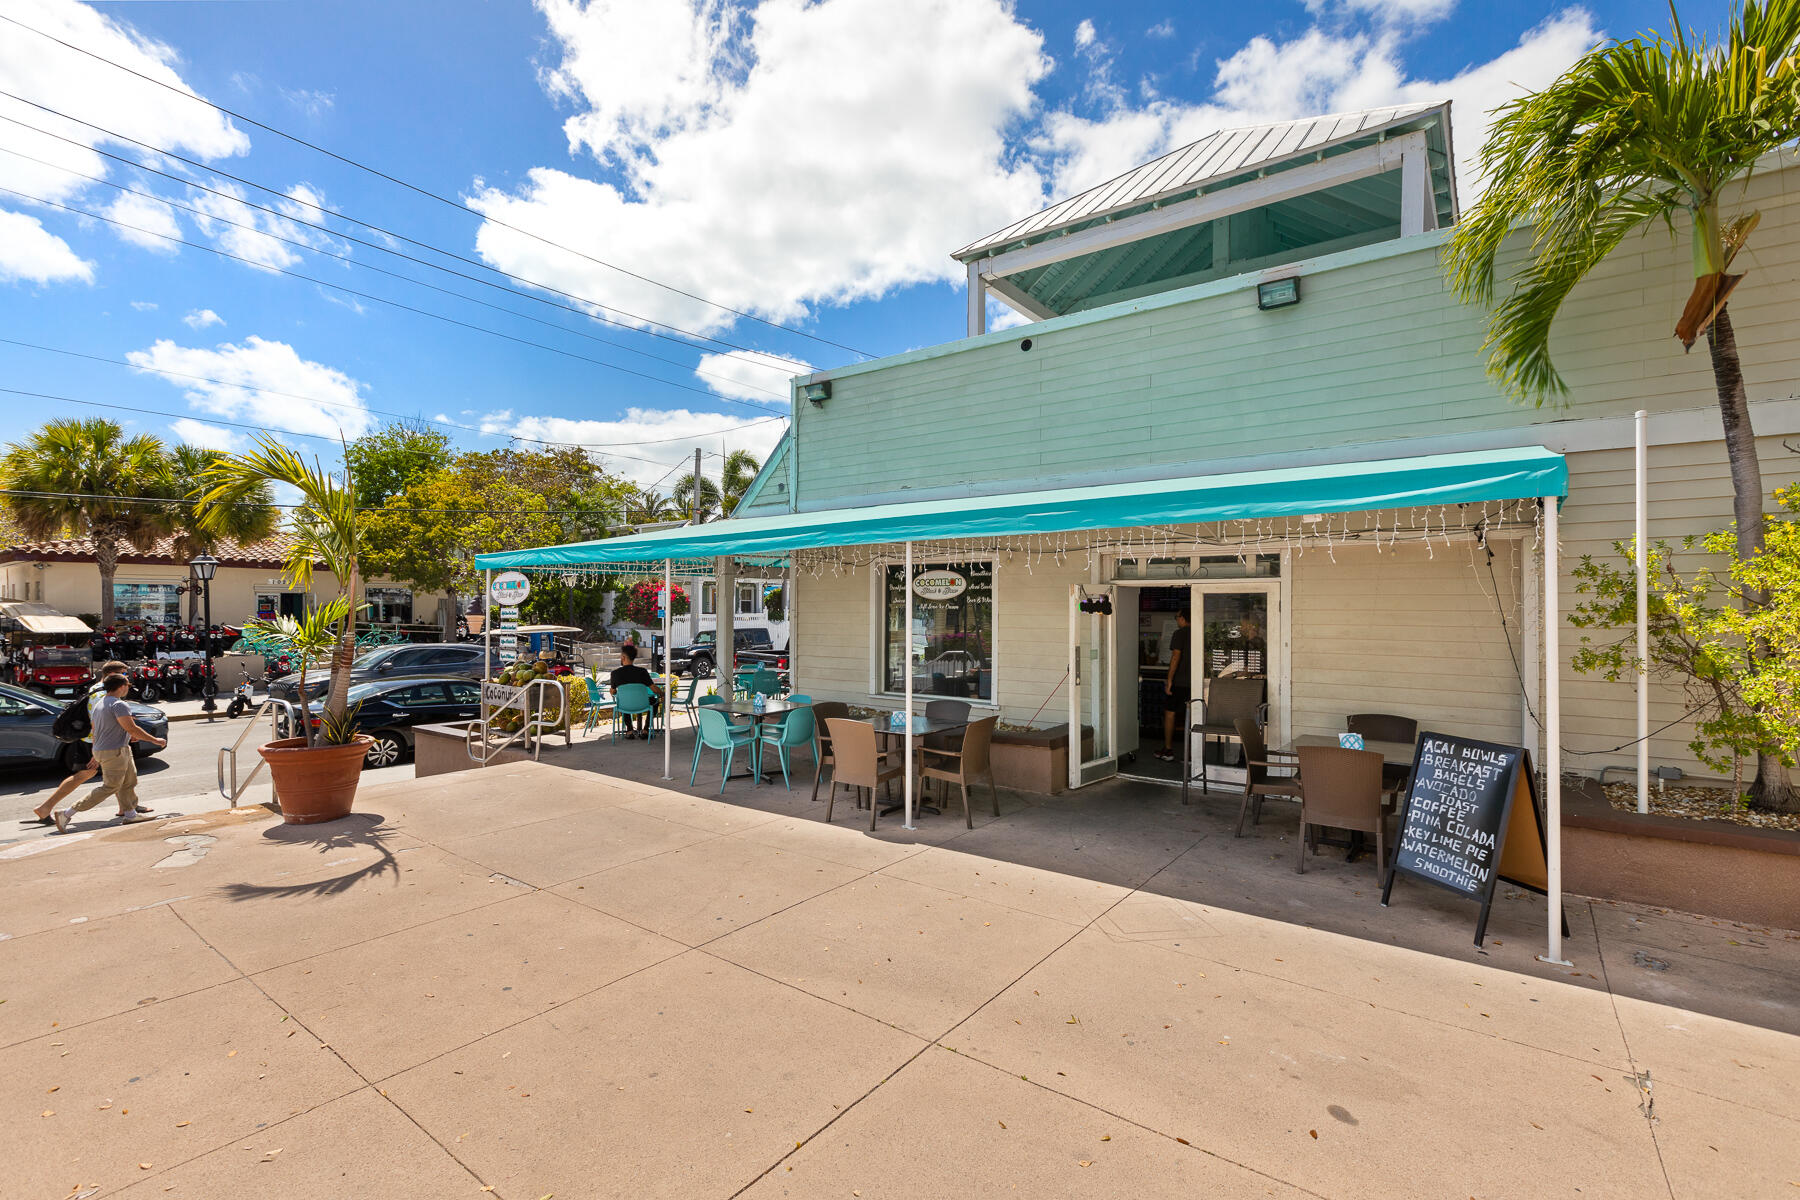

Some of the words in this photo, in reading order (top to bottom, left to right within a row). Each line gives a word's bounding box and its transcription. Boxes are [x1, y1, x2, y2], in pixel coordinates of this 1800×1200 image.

[915, 578, 962, 587] COCOMELON
[1424, 740, 1455, 755] ACAI
[1462, 747, 1508, 766] BOWLS
[1424, 754, 1503, 781] BREAKFAST
[1433, 769, 1486, 791] BAGELS
[1417, 777, 1477, 801] AVOCADO
[1413, 797, 1467, 822] COFFEE
[1438, 793, 1479, 814] TOAST
[1410, 809, 1441, 829] PINA
[1446, 820, 1495, 850] COLADA
[1407, 825, 1431, 840] KEY
[1431, 833, 1462, 852] LIME
[1465, 843, 1489, 861] PIE
[1403, 838, 1489, 882] WATERMELON
